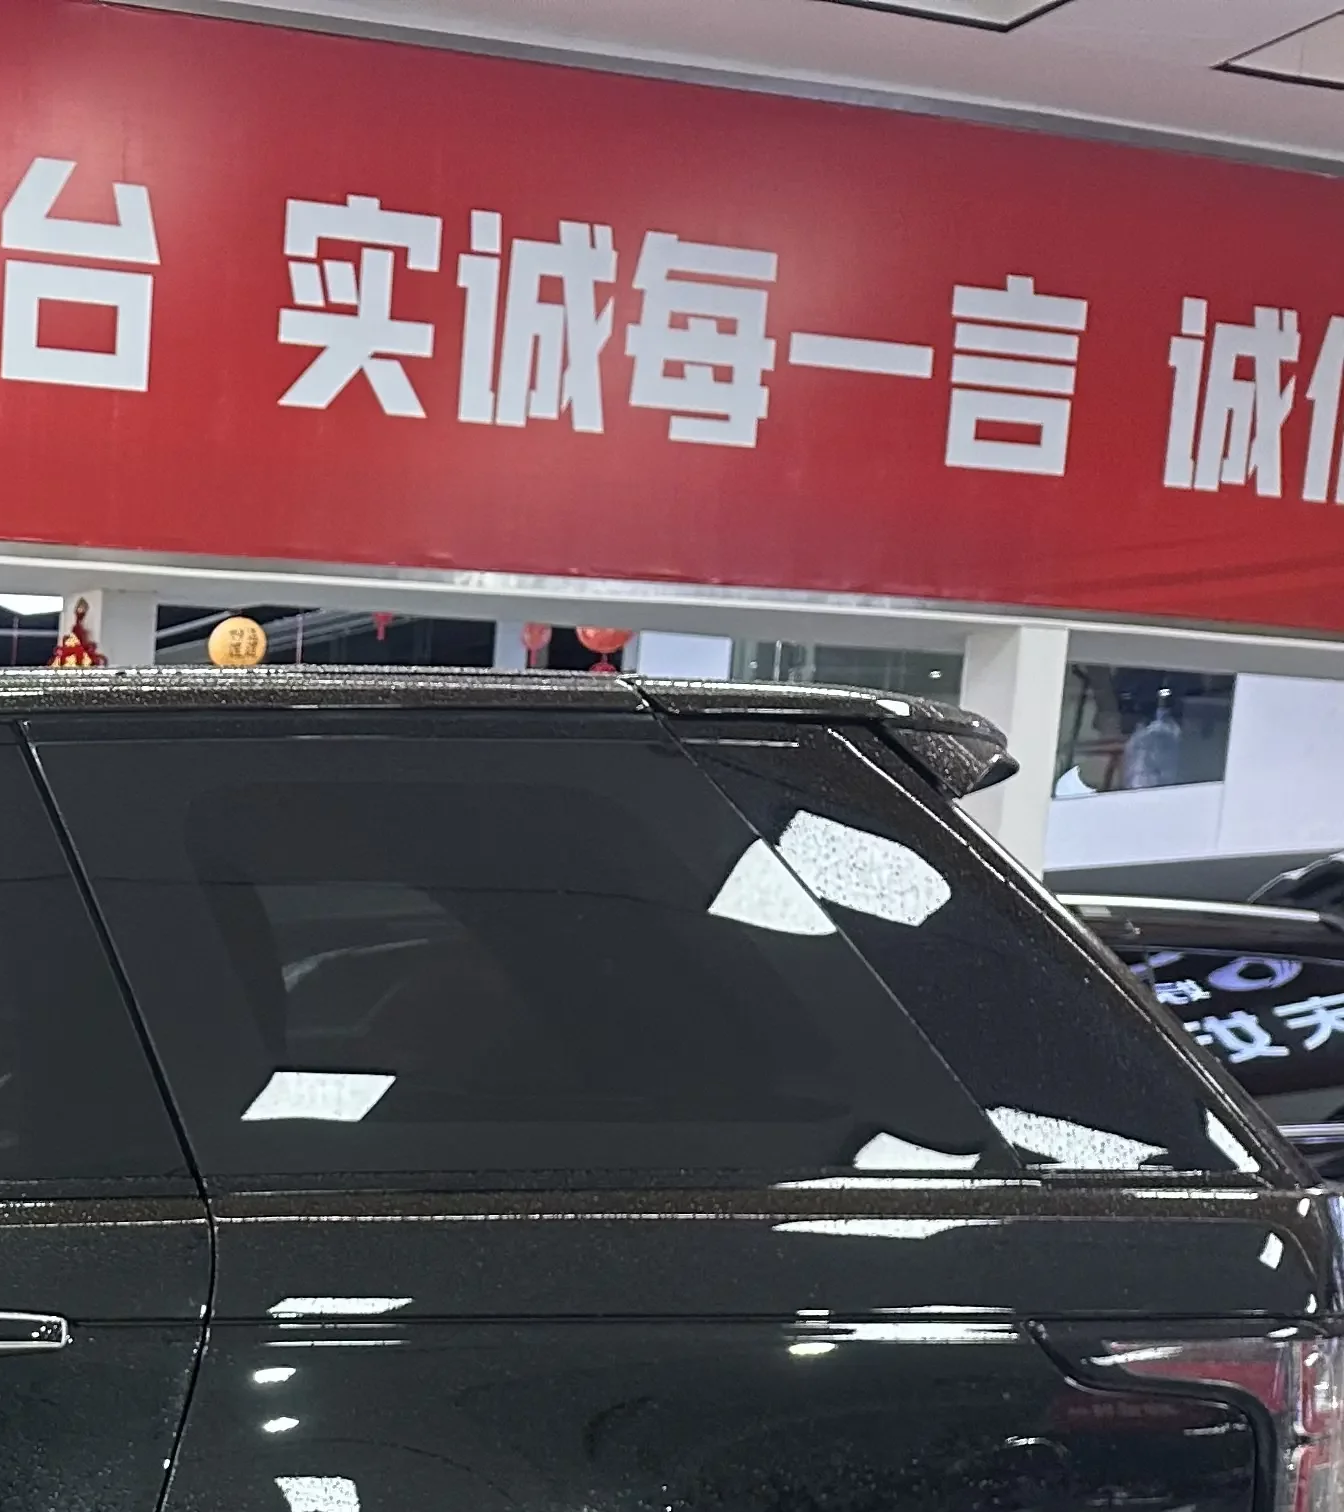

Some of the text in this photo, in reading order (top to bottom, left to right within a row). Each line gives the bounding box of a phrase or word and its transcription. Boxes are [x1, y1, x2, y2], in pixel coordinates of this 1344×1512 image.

[277, 194, 1088, 477] 实诚每一言
